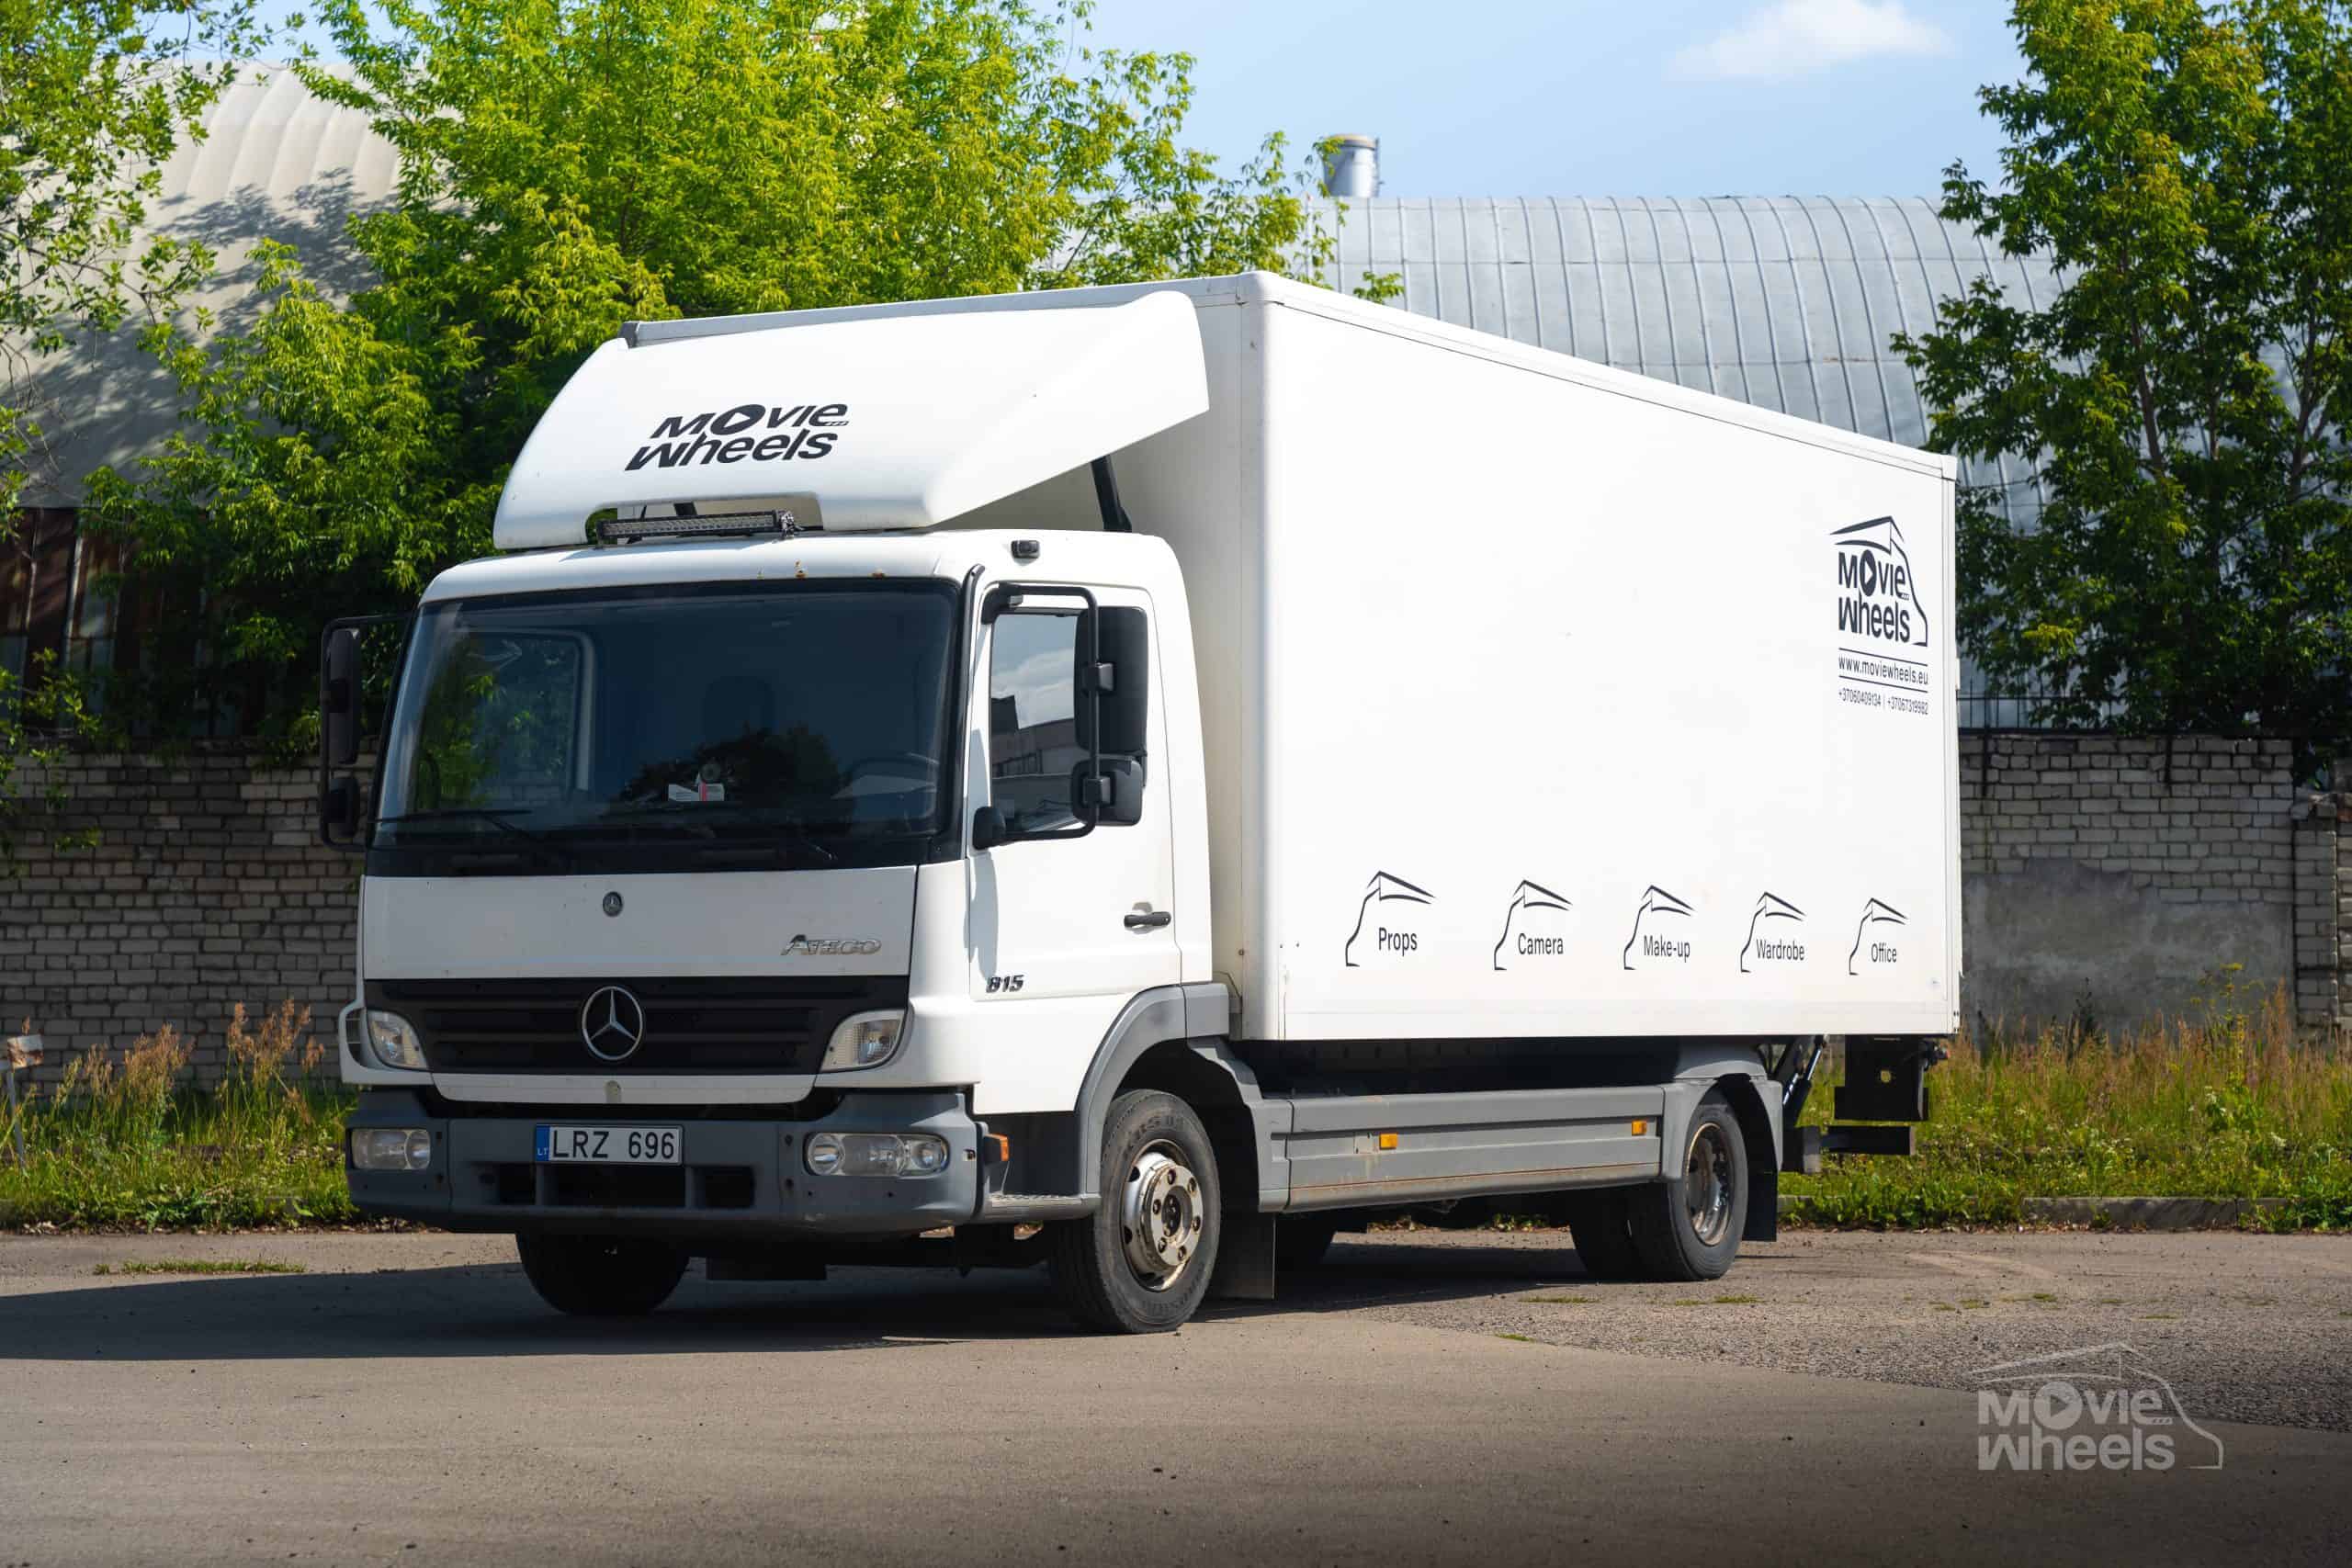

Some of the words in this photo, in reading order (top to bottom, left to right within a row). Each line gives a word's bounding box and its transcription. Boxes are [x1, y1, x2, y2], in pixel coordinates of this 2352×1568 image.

[624, 428, 839, 471] Wheels
[1838, 590, 1910, 643] Wheels
[1838, 656, 1928, 685] www.moviewheels.eu
[1378, 927, 1418, 956] Props
[1518, 932, 1564, 955] Camera
[1644, 935, 1690, 963] Make-up
[1756, 939, 1805, 961] Wardrobe
[1871, 942, 1897, 964] Office
[986, 975, 1024, 993] 815
[552, 1130, 610, 1158] LRZ
[628, 1131, 674, 1159] 696
